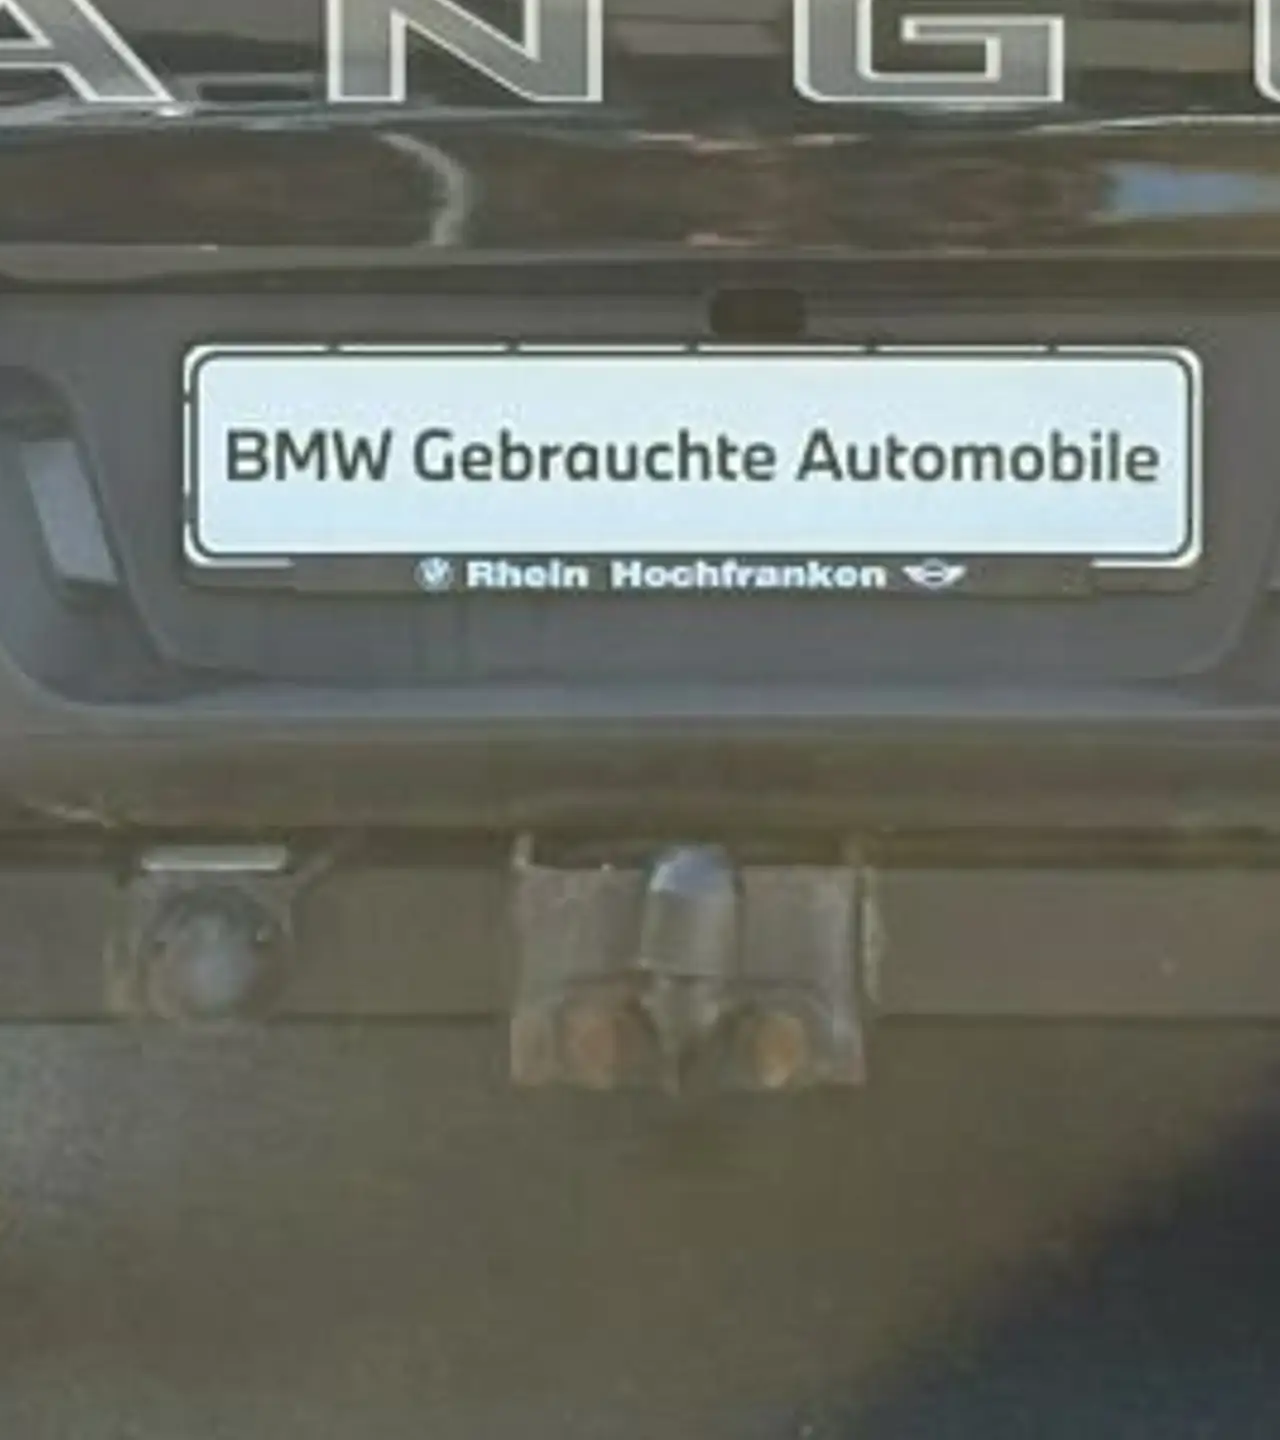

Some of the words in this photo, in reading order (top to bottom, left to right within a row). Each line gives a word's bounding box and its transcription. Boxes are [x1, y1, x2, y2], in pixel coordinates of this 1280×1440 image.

[226, 428, 391, 482] BMW
[414, 428, 776, 482] Gebrauchte
[795, 428, 1160, 482] Automobile
[466, 561, 588, 588] Rhein
[610, 561, 887, 588] Hochfranken
